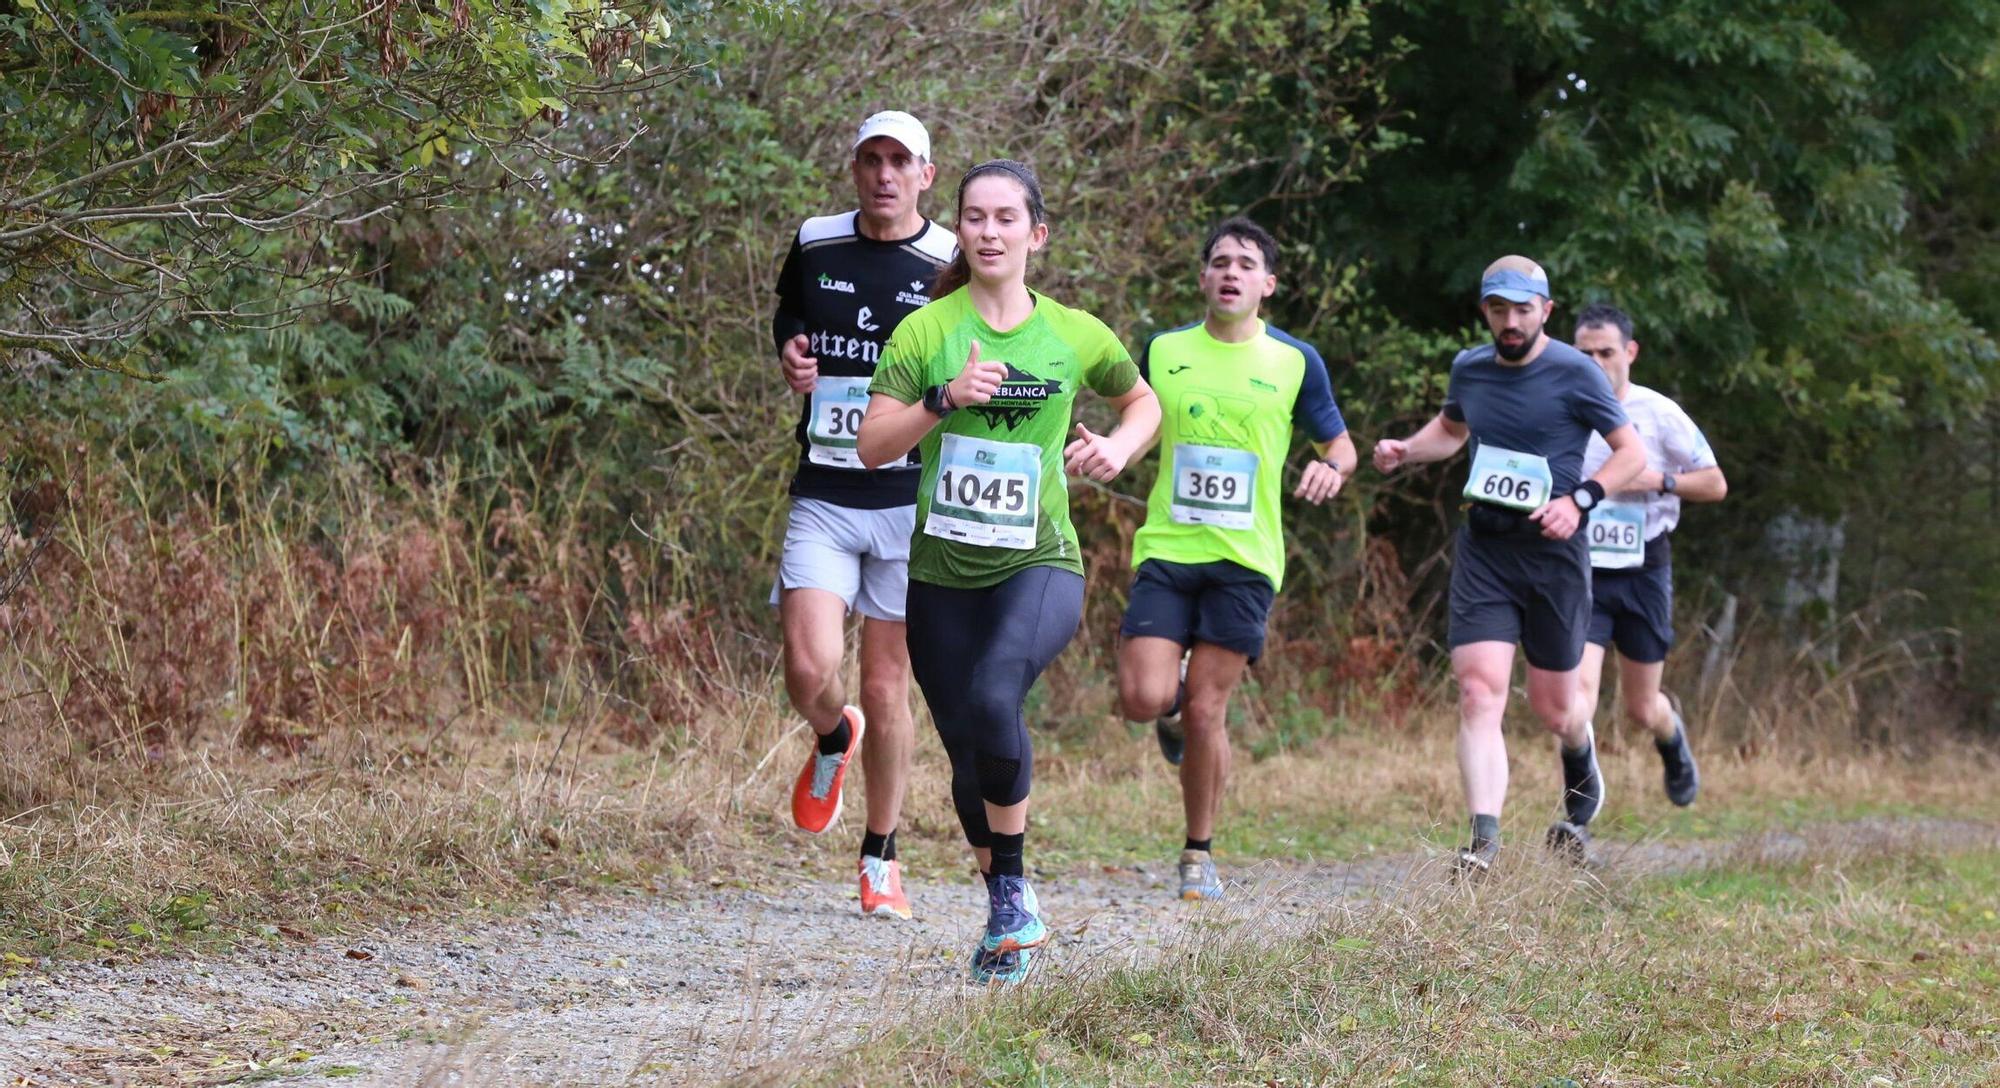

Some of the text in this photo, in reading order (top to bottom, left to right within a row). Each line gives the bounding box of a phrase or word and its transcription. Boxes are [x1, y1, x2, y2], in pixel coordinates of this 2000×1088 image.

[820, 279, 855, 293] LUGA
[828, 407, 865, 436] 30
[941, 470, 1025, 512] 1045
[1189, 472, 1237, 500] 369
[1483, 474, 1531, 502] 606
